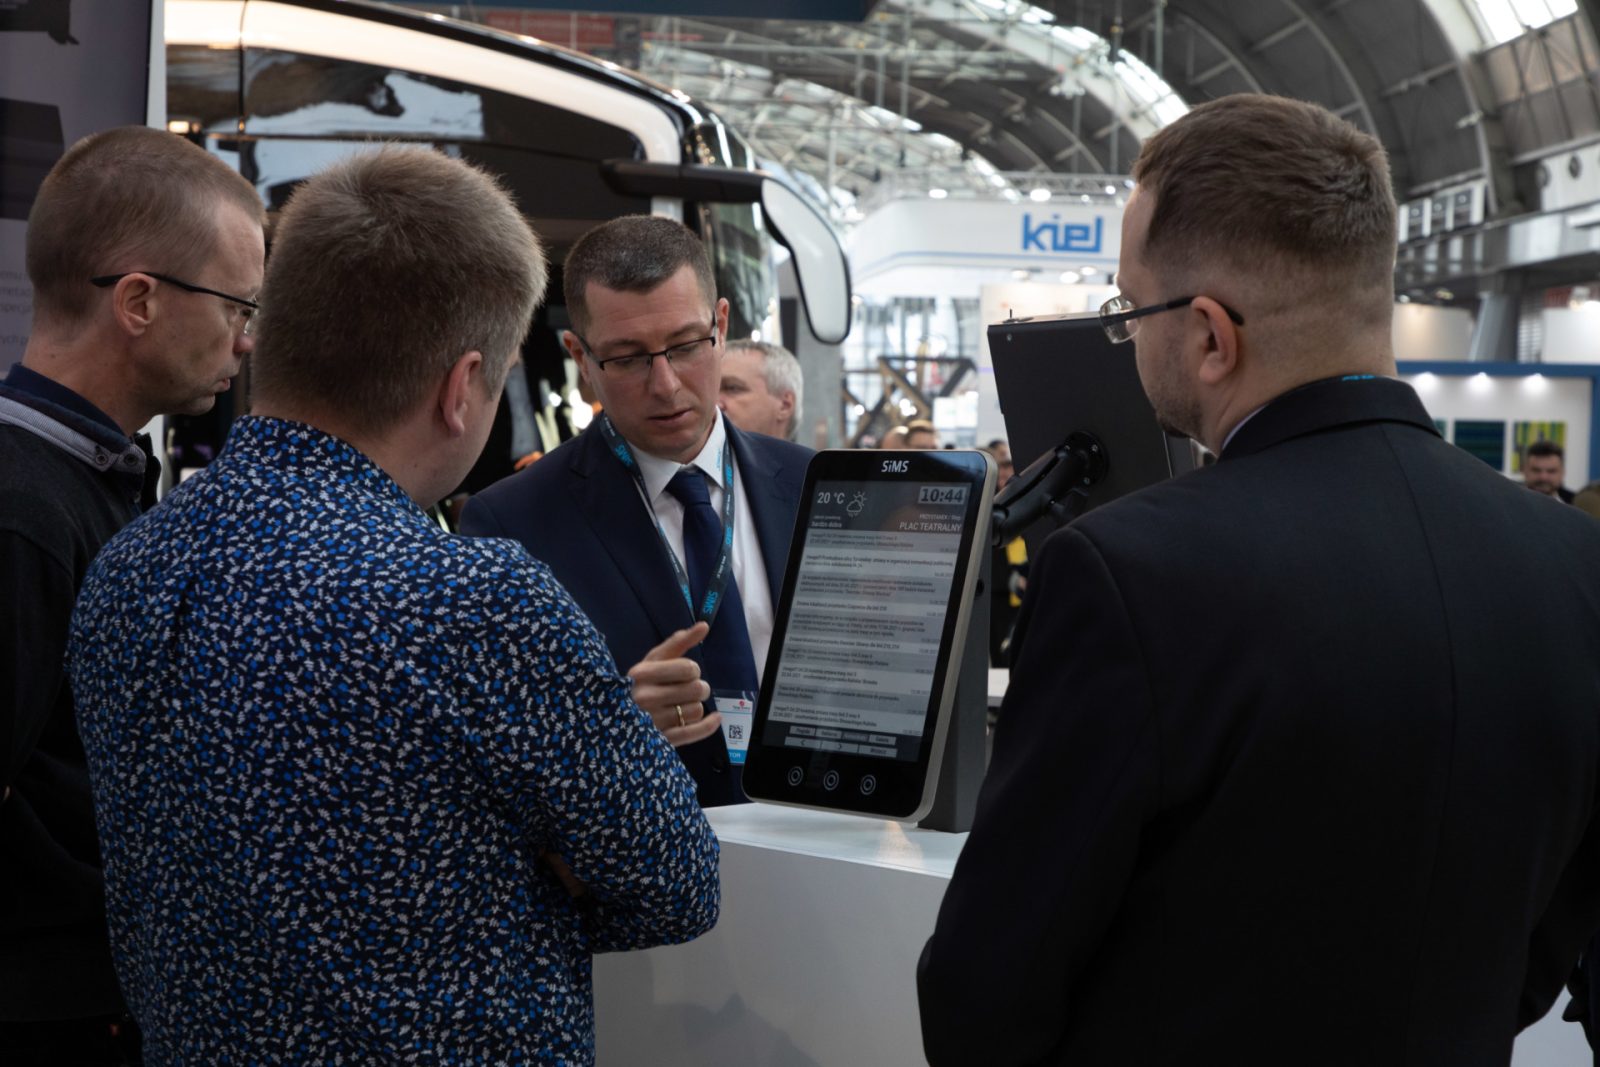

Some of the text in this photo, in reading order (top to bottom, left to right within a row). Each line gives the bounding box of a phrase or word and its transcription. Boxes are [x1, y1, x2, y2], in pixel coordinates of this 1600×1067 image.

[1023, 213, 1103, 253] kiel
[817, 492, 831, 505] 20
[921, 488, 964, 503] 10:44
[899, 521, 962, 532] PLAC TEATRALNY
